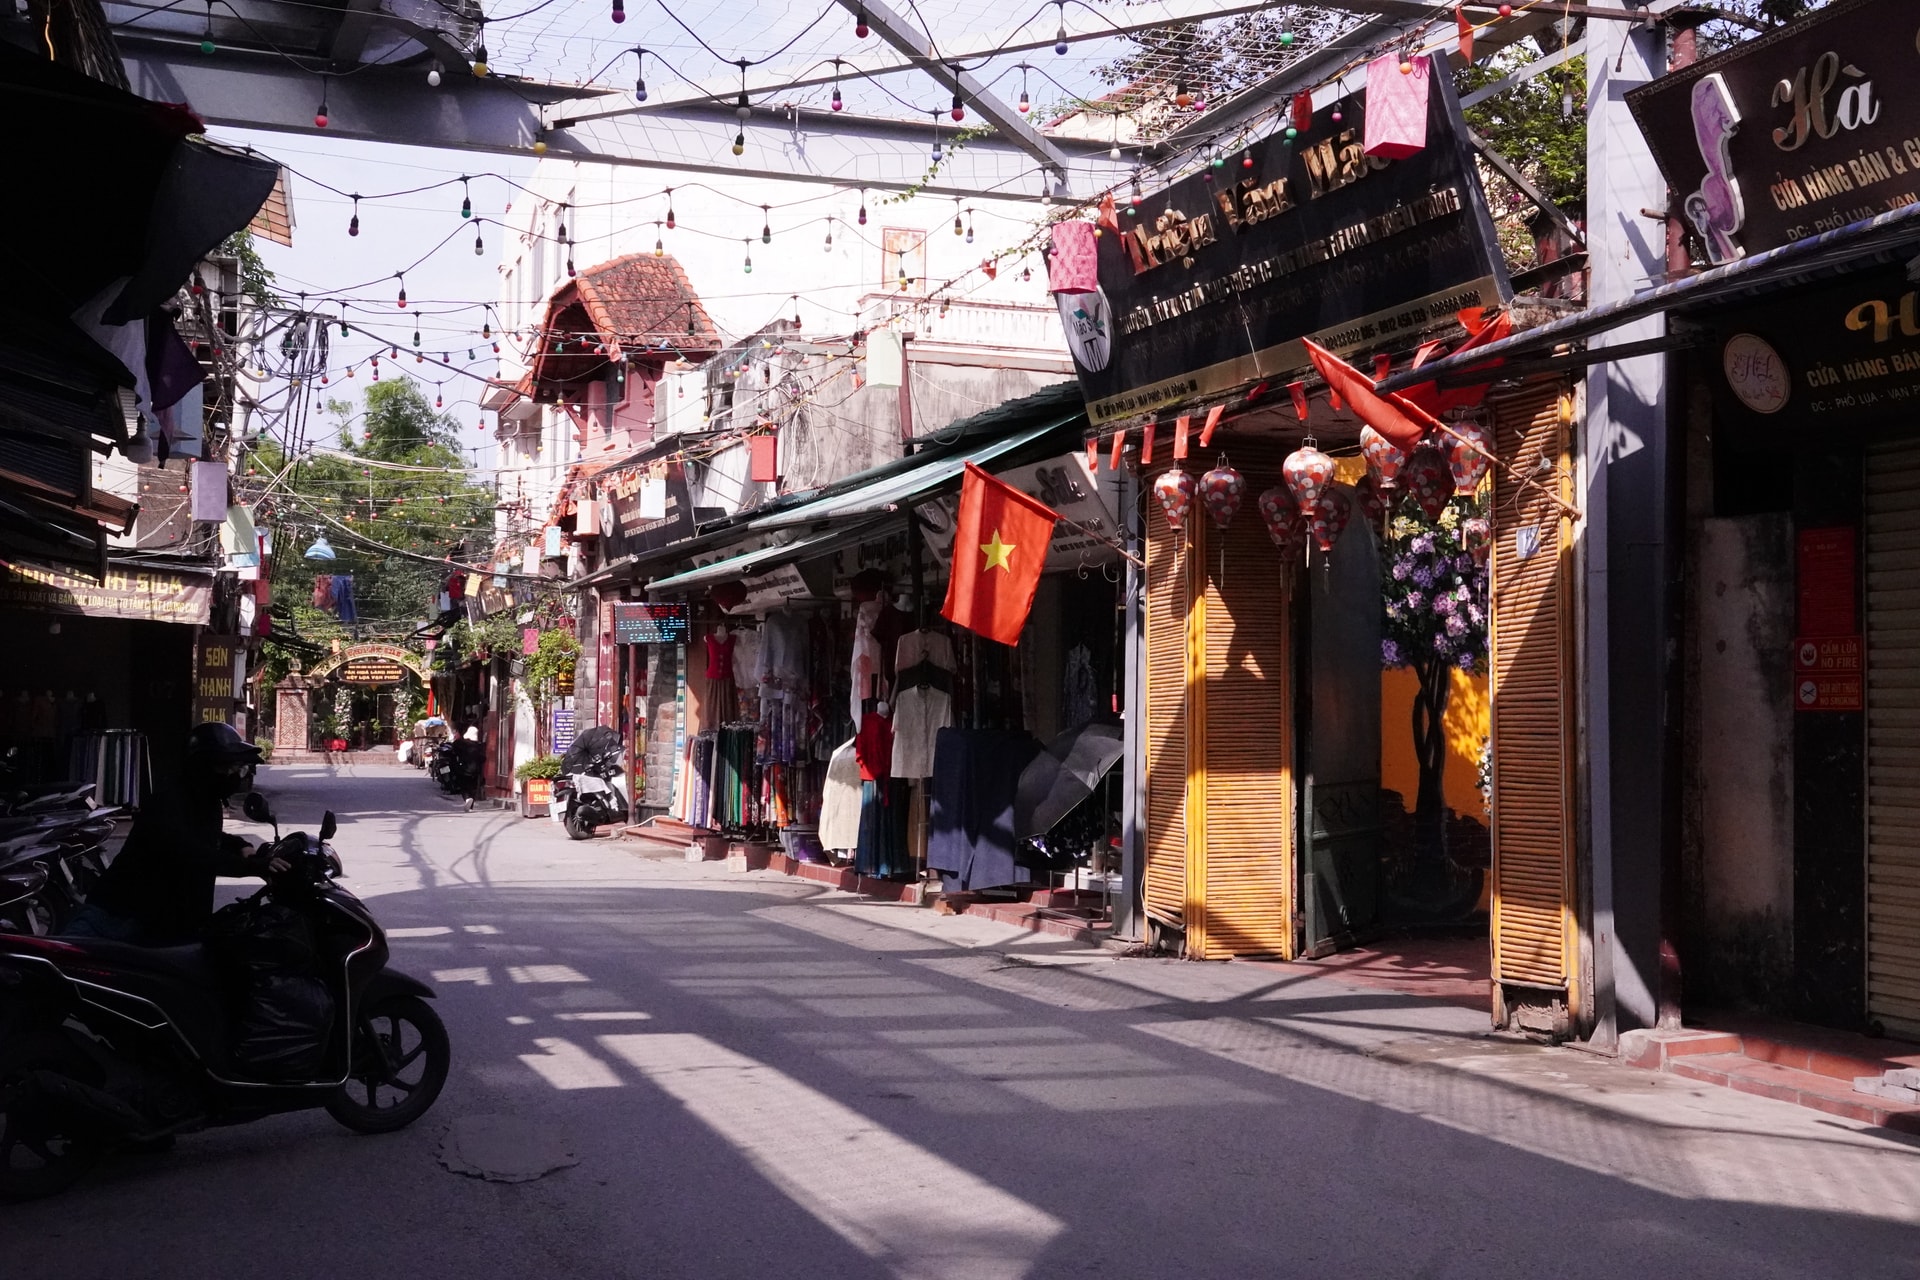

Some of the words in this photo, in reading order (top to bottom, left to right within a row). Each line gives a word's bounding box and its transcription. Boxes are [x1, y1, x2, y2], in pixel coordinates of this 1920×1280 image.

[1771, 50, 1880, 151] Hà
[1770, 171, 1808, 212] CỬA
[1801, 165, 1855, 202] HÀNG
[1848, 149, 1892, 188] BÁN
[1886, 146, 1909, 175] &
[1213, 177, 1297, 236] Văn
[1806, 361, 1840, 387] CỬA
[1842, 357, 1889, 381] HÀNG
[136, 572, 185, 596] SILK
[185, 602, 199, 613] CAO
[205, 645, 228, 667] SƠN
[1821, 657, 1834, 668] NO
[1836, 657, 1858, 668] FIRE
[199, 677, 232, 701] HẠNH
